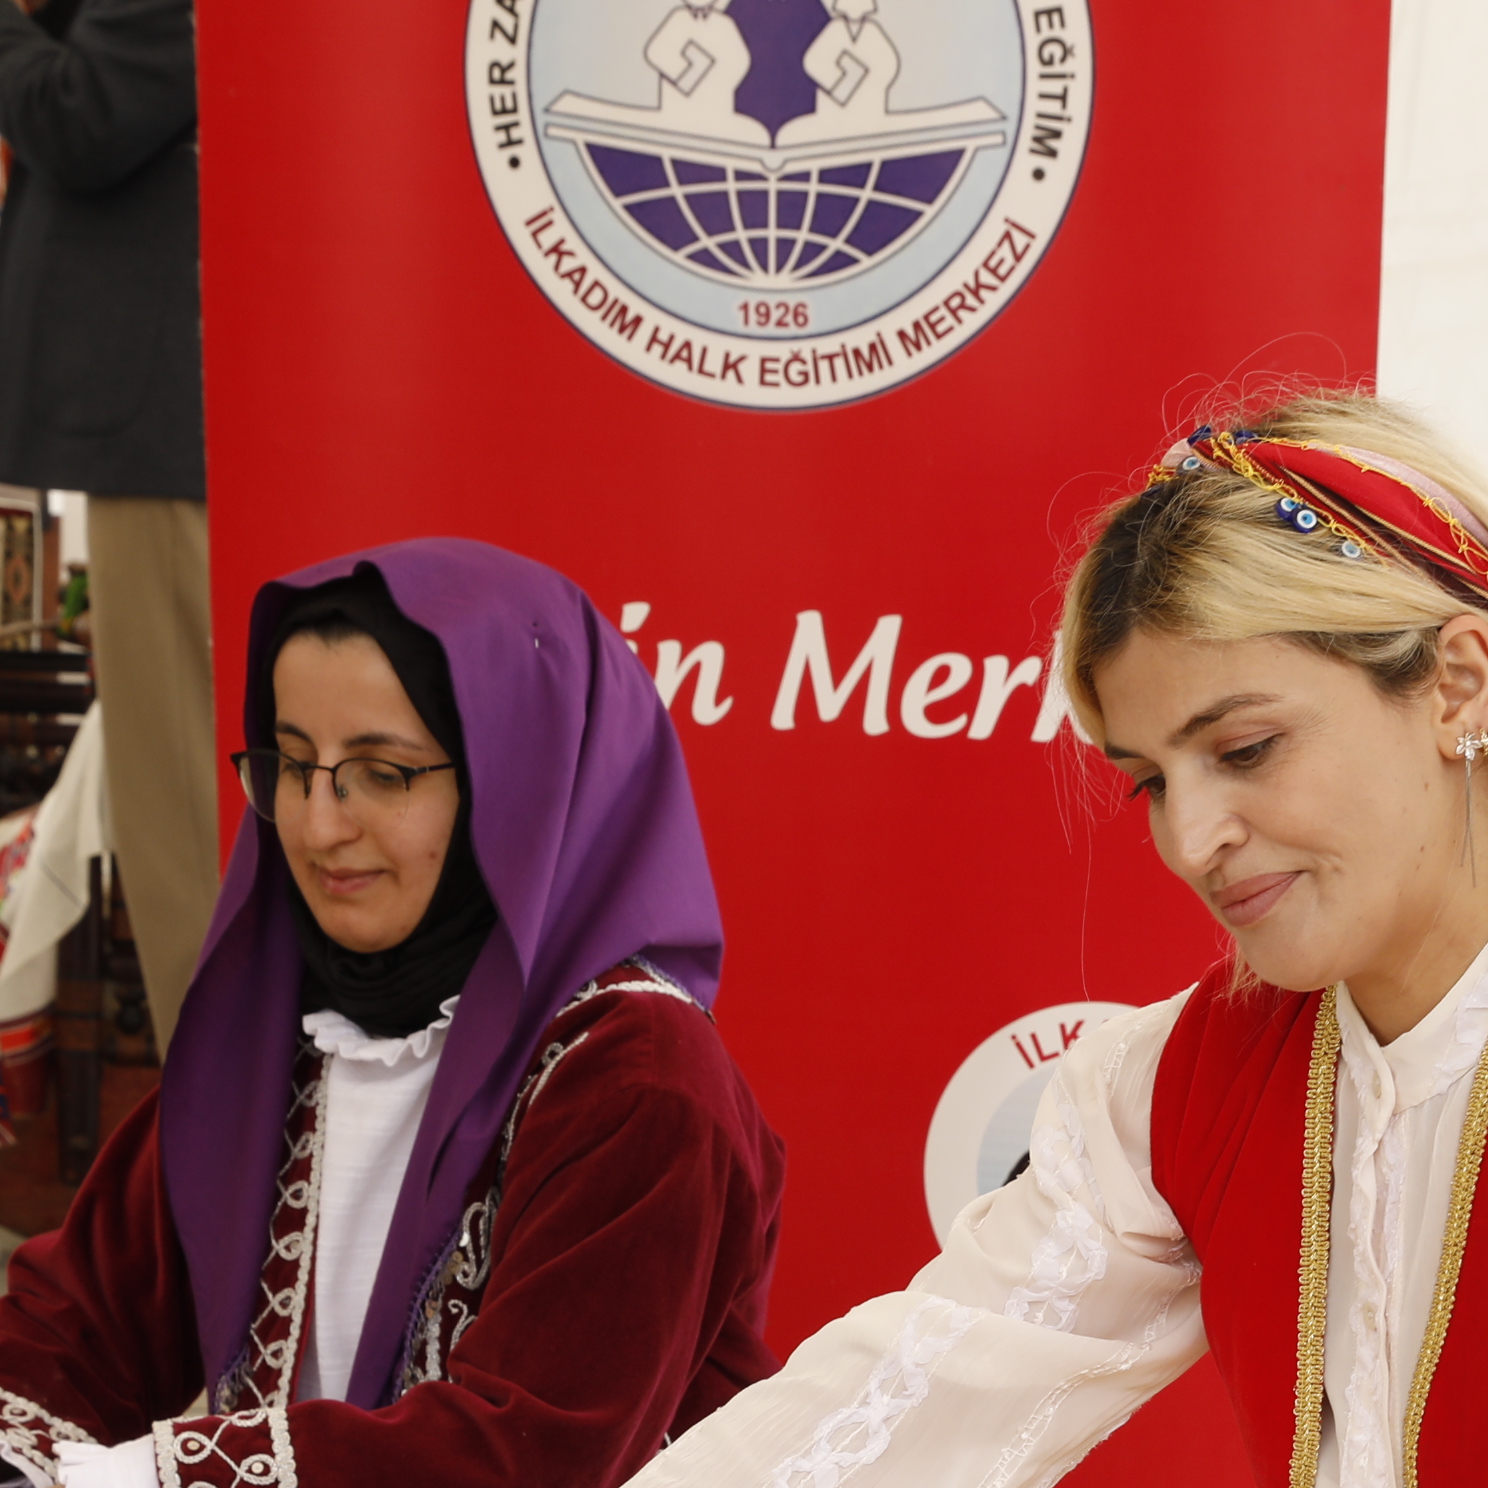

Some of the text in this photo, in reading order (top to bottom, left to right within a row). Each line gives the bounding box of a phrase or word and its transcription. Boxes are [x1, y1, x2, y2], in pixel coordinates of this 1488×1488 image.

[488, 60, 524, 149] HER
[1028, 6, 1076, 160] EĞİTİM
[524, 206, 1037, 388] İLKADIM HALK EĞİTİMİ MERKEZİ
[738, 300, 810, 328] 1926
